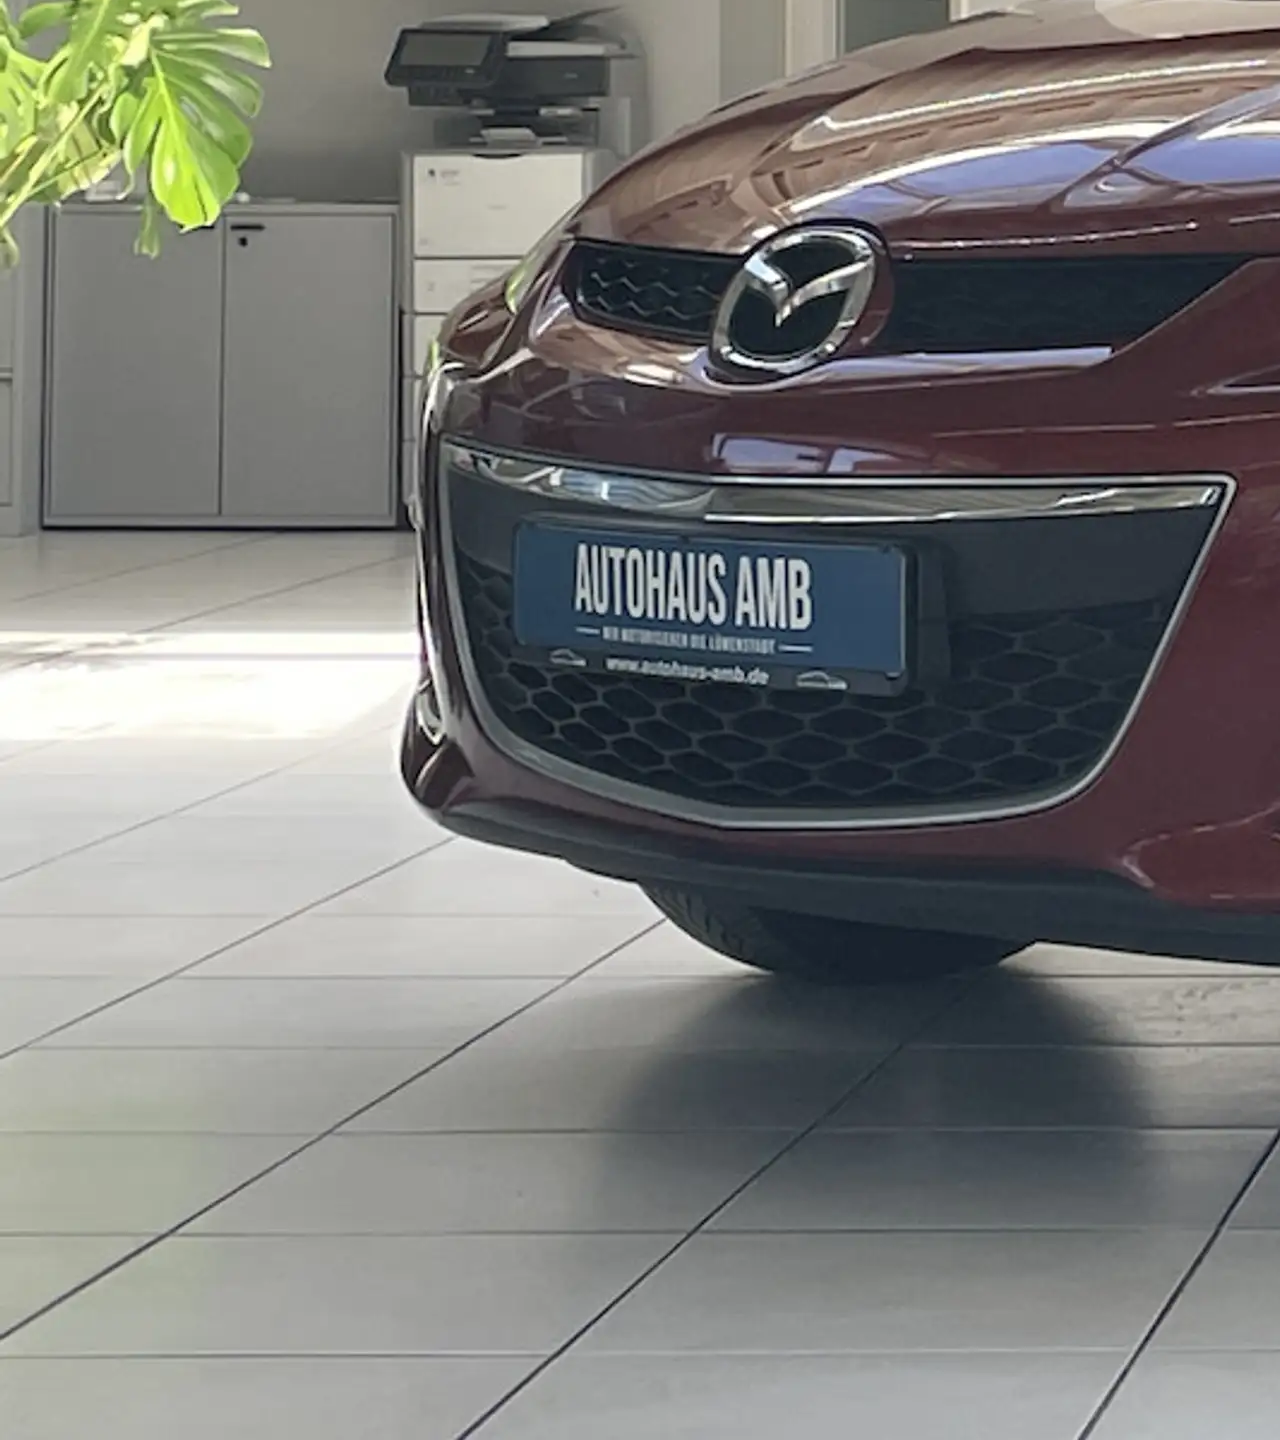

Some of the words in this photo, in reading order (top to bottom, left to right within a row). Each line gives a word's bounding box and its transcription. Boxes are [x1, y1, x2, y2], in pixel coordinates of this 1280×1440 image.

[575, 543, 727, 626] AUTOHAUS
[734, 555, 813, 630] AMB
[605, 656, 770, 685] www.autohaus-amb.de
